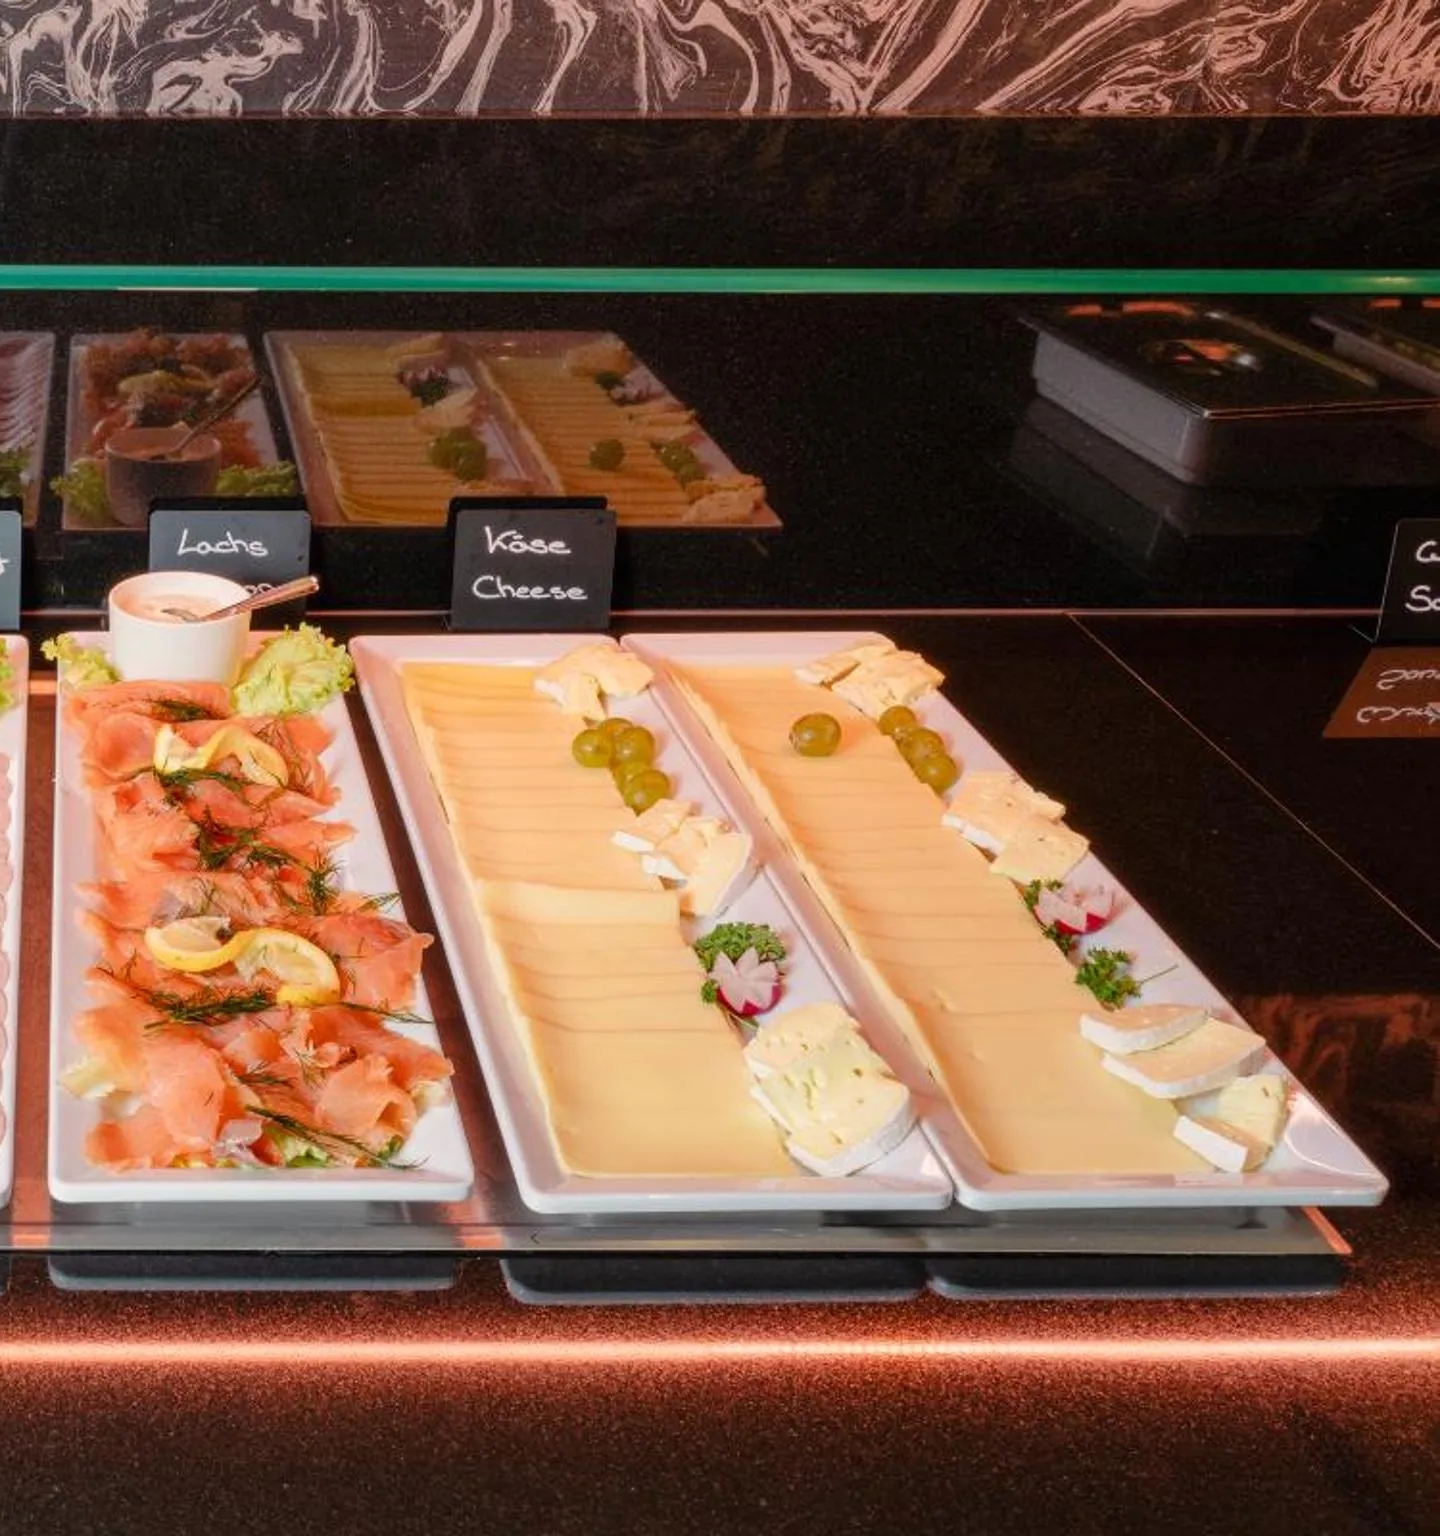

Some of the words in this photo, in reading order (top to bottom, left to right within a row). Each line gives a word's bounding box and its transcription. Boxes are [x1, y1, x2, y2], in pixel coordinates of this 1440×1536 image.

[176, 528, 268, 557] Lachs
[484, 525, 571, 555] Käse
[472, 575, 588, 600] Cheese
